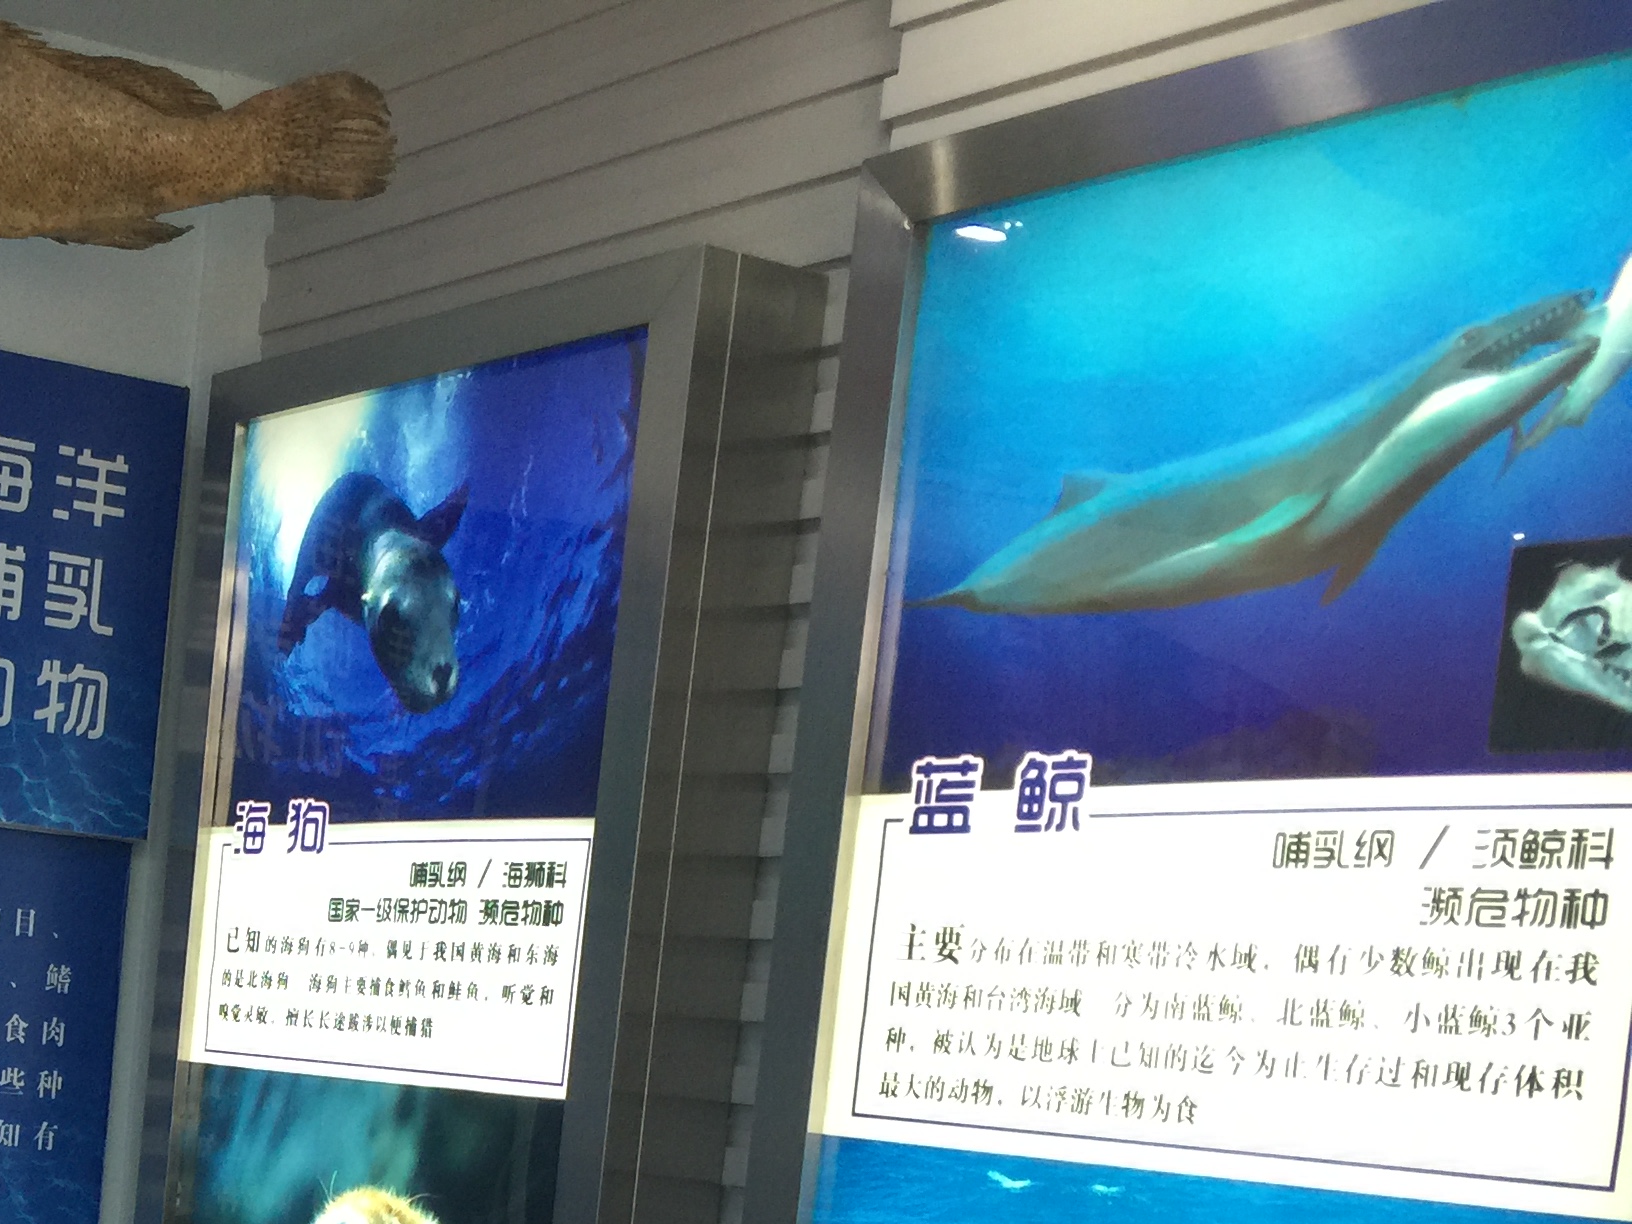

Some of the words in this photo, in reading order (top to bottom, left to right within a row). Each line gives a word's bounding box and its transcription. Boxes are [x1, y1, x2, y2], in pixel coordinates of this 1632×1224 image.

[909, 751, 1091, 835] 蓝鲸
[234, 799, 329, 855] 海狗
[1272, 829, 1395, 870] 哺乳纲
[1471, 827, 1615, 870] 须鲸科
[409, 861, 467, 888] 哺乳纲
[502, 860, 568, 889] 海狮科
[327, 896, 468, 925] 国家一级保护动物
[478, 898, 564, 927] 濒危物种
[1419, 886, 1610, 930] 濒危物种
